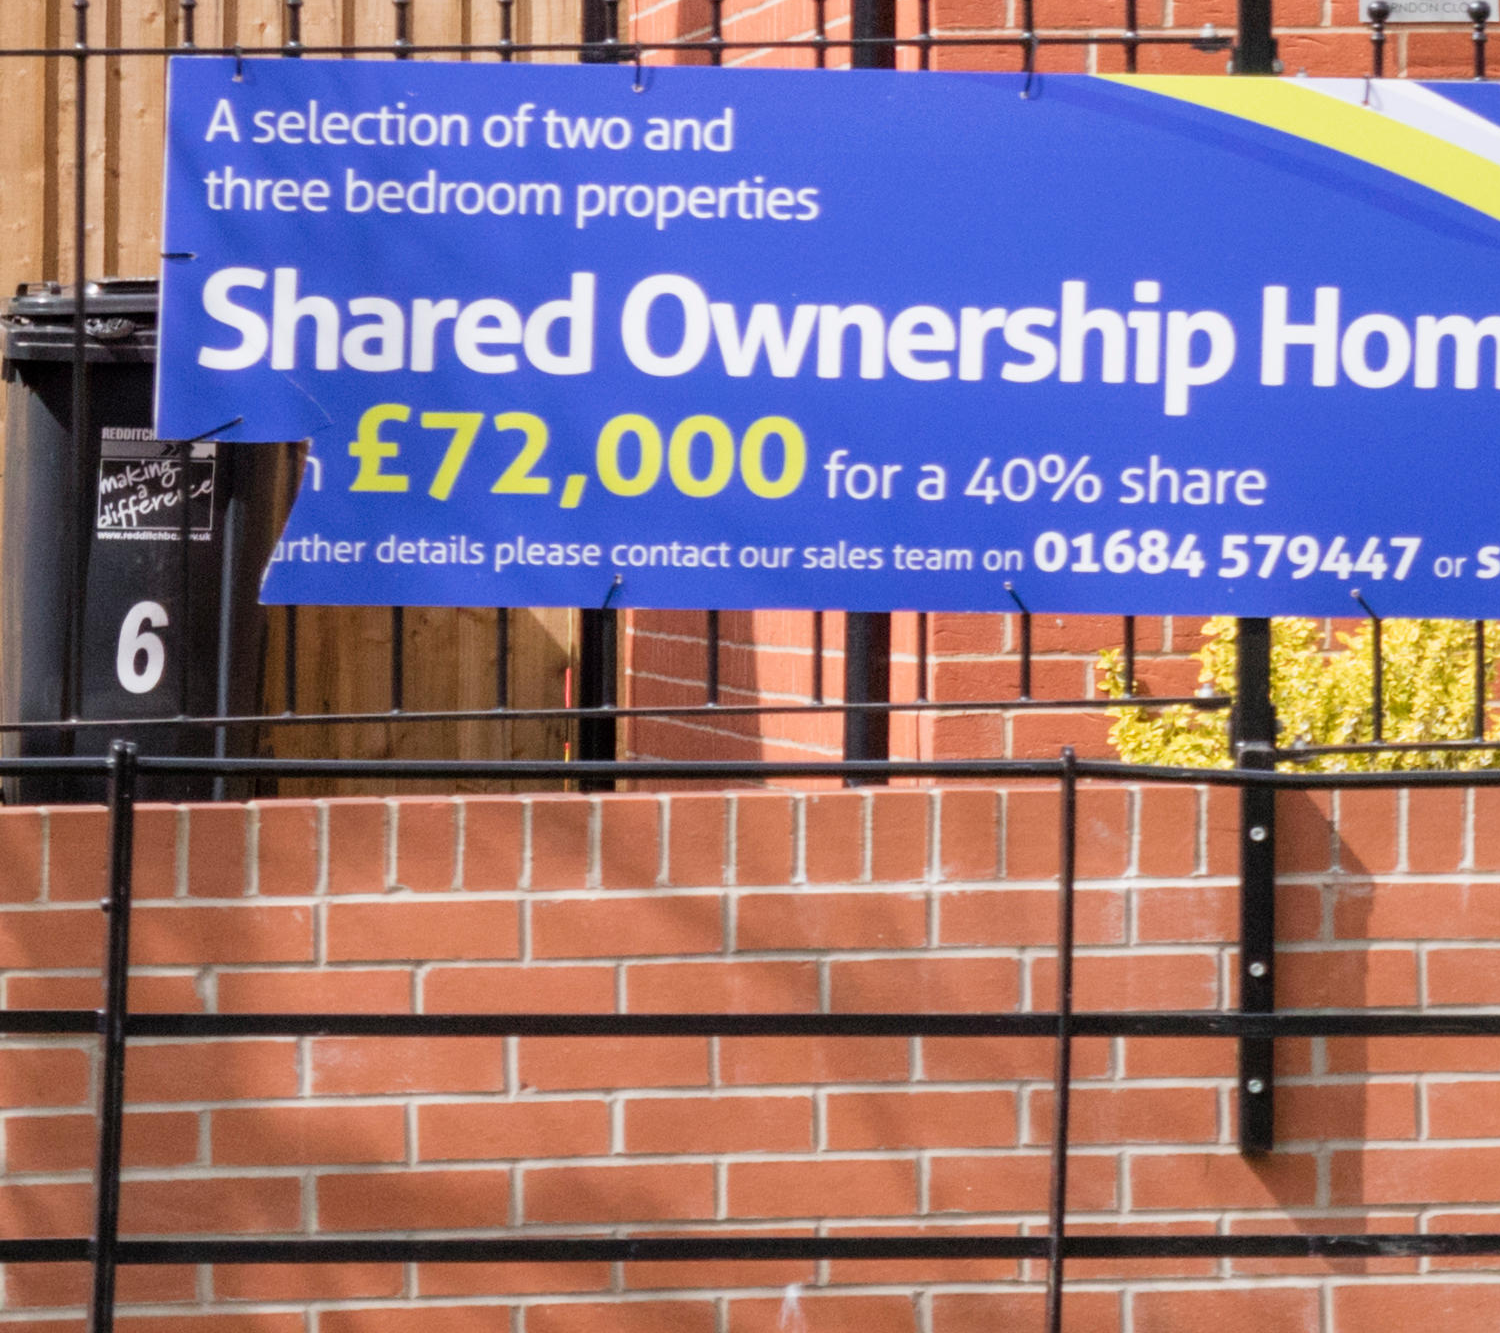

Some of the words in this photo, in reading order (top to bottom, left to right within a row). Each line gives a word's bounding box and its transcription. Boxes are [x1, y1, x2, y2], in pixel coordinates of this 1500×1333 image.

[204, 98, 241, 143] A
[252, 99, 470, 148] selection
[482, 102, 537, 149] of
[541, 109, 632, 151] two
[643, 106, 735, 153] and
[203, 165, 331, 213] three
[345, 167, 563, 217] bedroom
[575, 175, 821, 231] properties
[197, 266, 597, 376] Shared
[613, 272, 1237, 416] Ownership
[100, 459, 182, 495] making
[348, 403, 808, 509] £72,000
[823, 449, 903, 501] for
[916, 463, 947, 501] a
[963, 453, 1103, 505] 40%
[1119, 454, 1268, 507] share
[98, 480, 213, 528] differee
[137, 484, 148, 499] a
[97, 531, 211, 541] www.redditchbc.v.uk
[270, 533, 367, 563] urther
[376, 533, 486, 565] details
[494, 535, 603, 574] please
[610, 540, 732, 569] contact
[738, 545, 796, 570] our
[802, 539, 884, 571] sales
[892, 543, 974, 572] team
[981, 548, 1025, 572] on
[1033, 529, 1208, 578] 01684
[1217, 533, 1423, 582] 579447
[1433, 555, 1467, 579] or
[116, 600, 169, 694] 6
